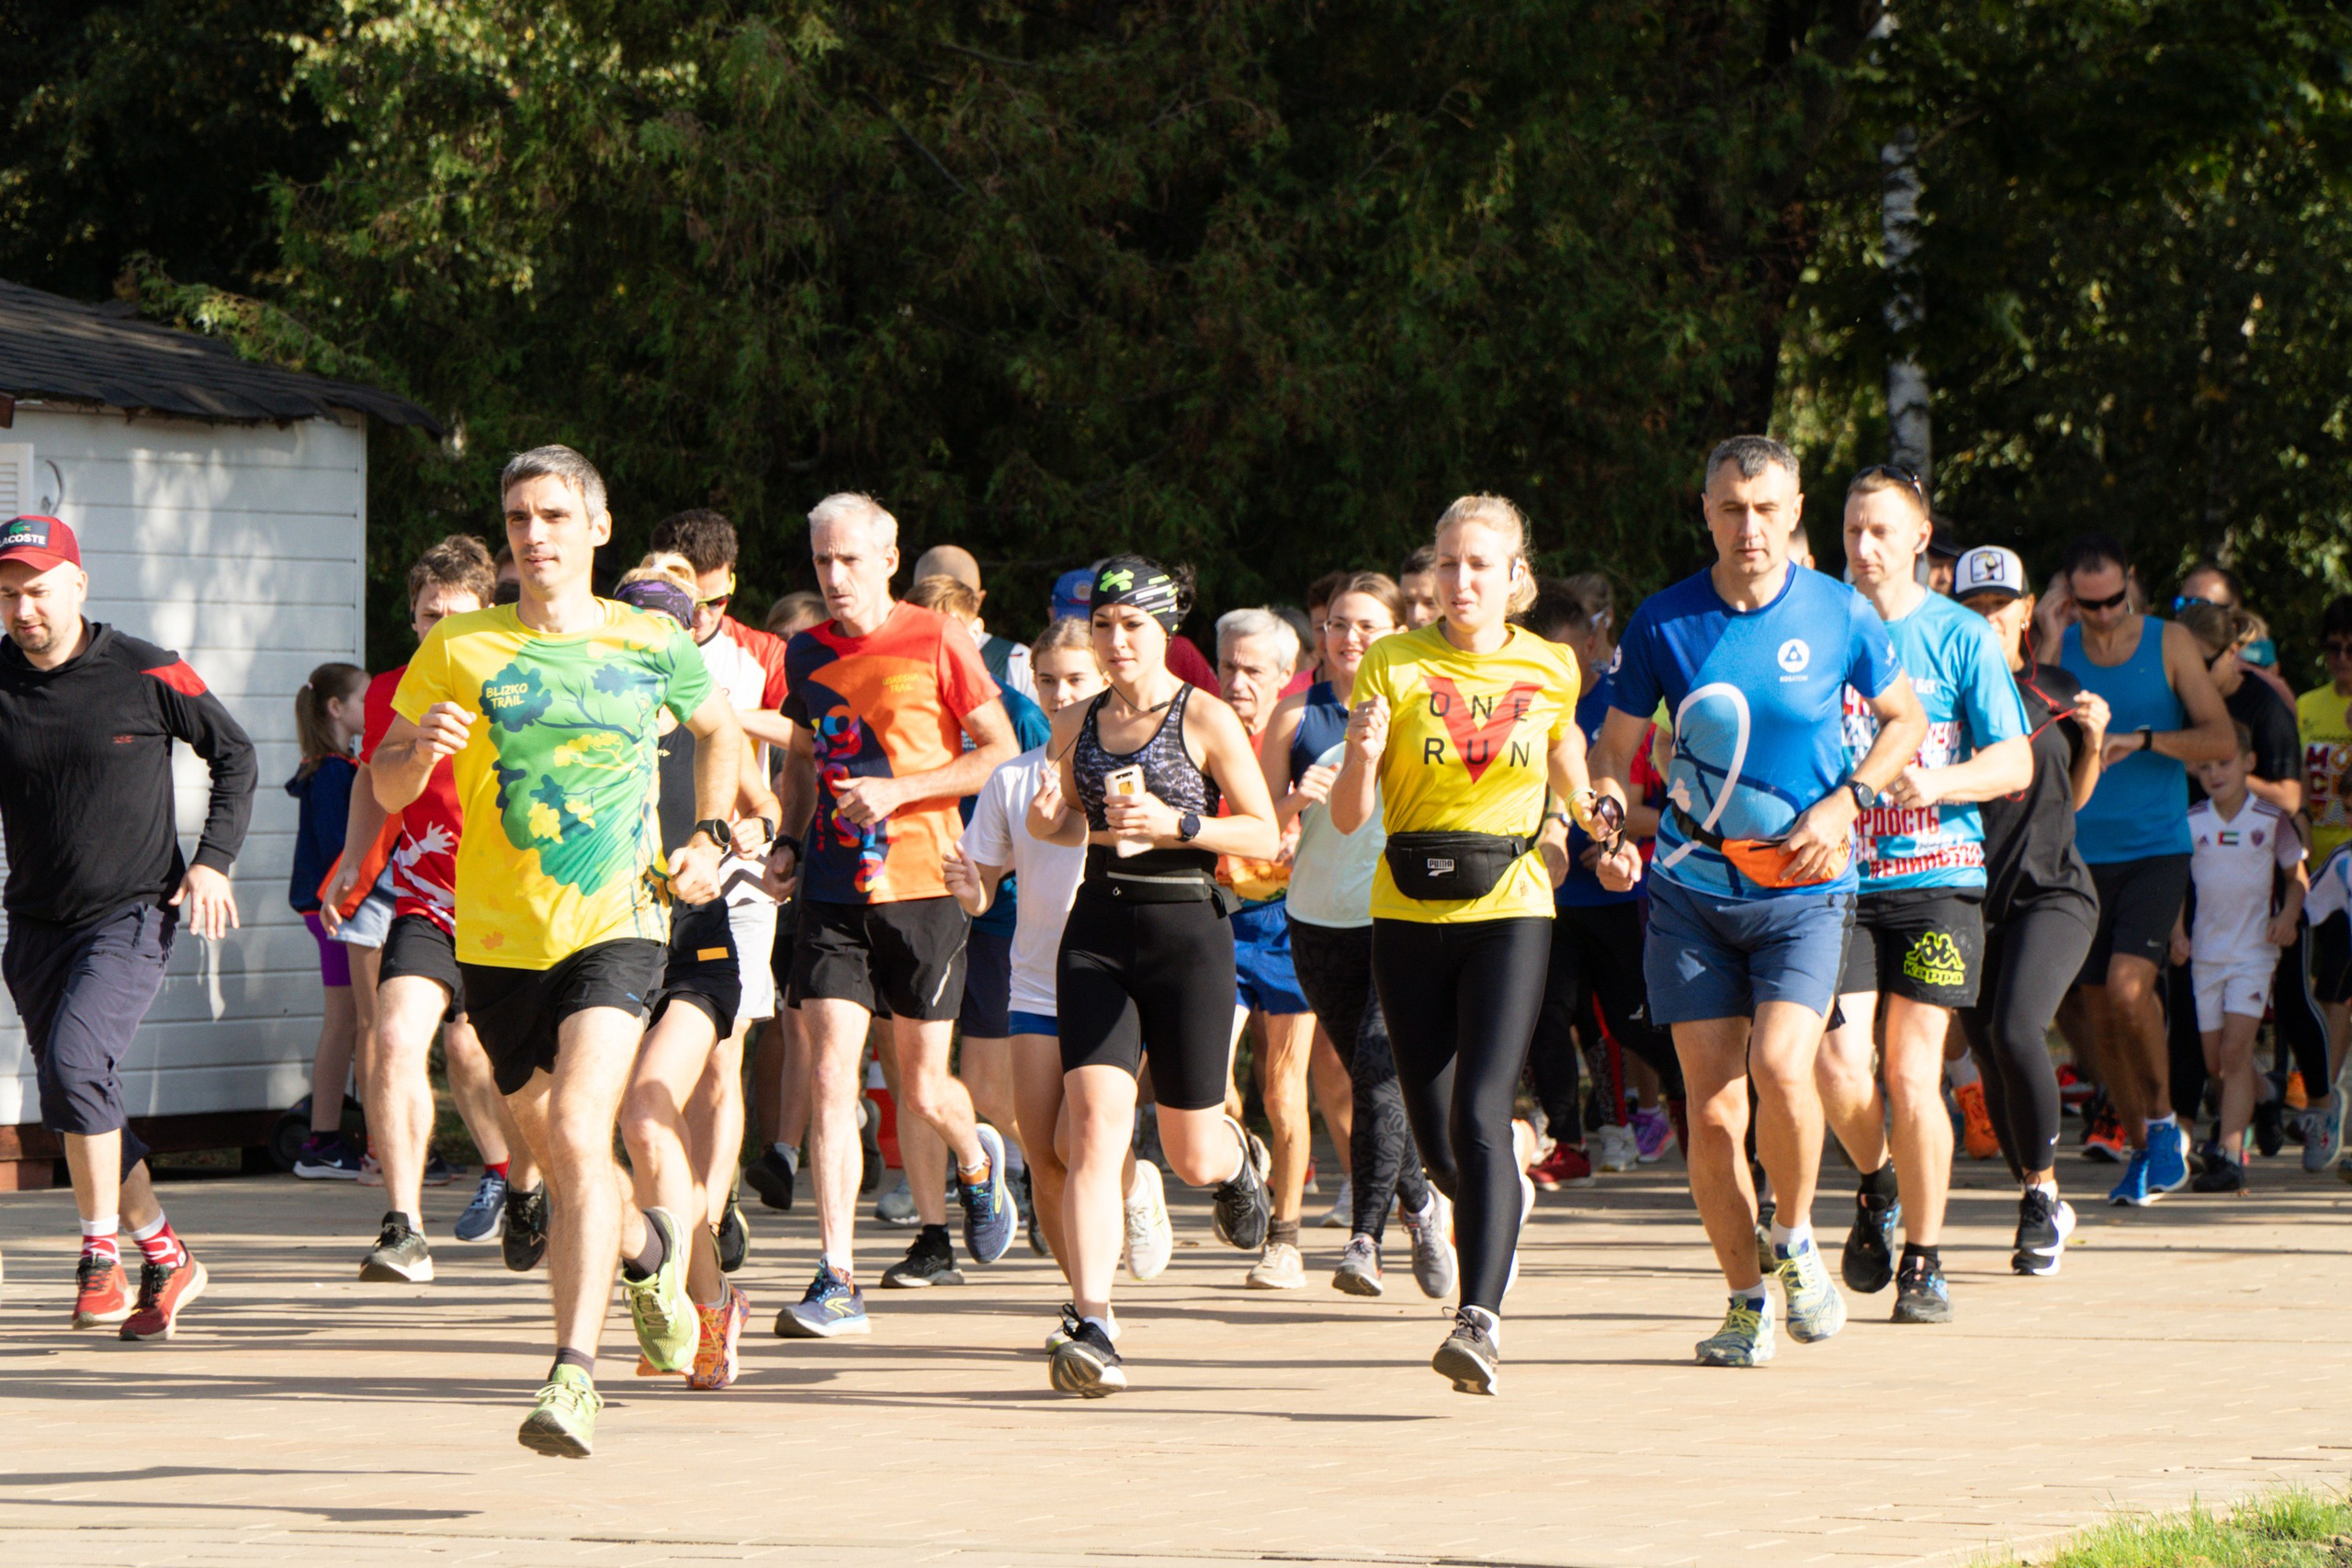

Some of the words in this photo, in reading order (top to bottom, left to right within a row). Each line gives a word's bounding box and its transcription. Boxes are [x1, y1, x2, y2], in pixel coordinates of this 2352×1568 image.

[486, 682, 528, 698] BLIZKO
[490, 694, 526, 709] TRAIL
[1430, 691, 1530, 722] ONE
[1423, 737, 1530, 767] RUN
[1428, 858, 1454, 869] PUMA
[1904, 960, 1964, 986] Kappa
